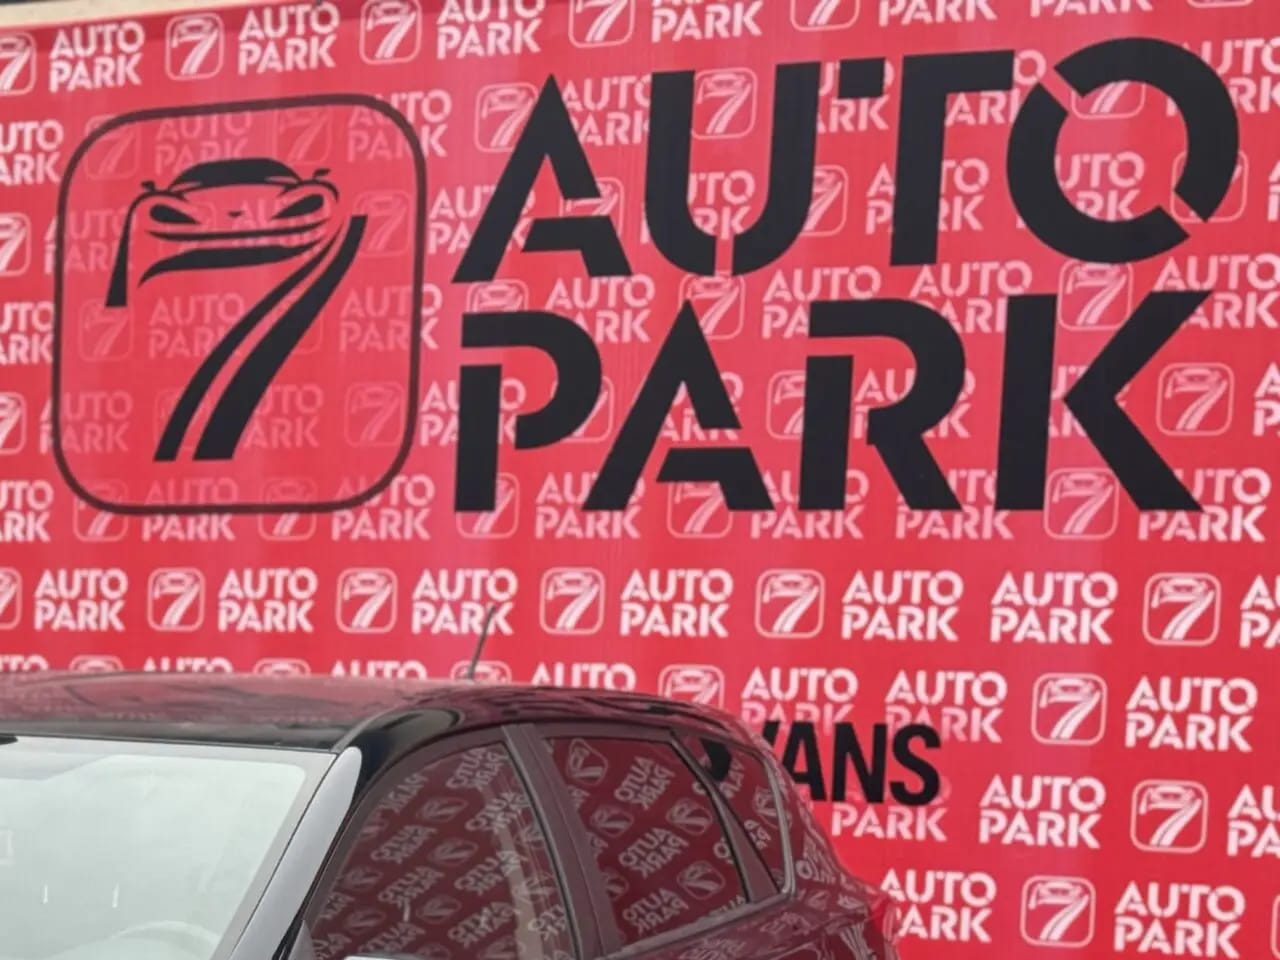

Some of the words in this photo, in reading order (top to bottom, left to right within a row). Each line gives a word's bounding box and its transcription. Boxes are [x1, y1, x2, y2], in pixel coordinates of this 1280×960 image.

[50, 22, 144, 59] AUTO
[239, 3, 339, 43] AUTO
[437, 20, 541, 59] PARK
[652, 2, 762, 43] PARK
[49, 54, 141, 92] PARK
[239, 37, 335, 75] PARK
[451, 37, 1239, 284] AUTO
[544, 274, 655, 309] AUTO
[762, 266, 882, 301] AUTO
[909, 260, 1032, 296] AUTO
[454, 290, 1214, 513] PARK
[142, 509, 235, 541] PARK
[332, 508, 426, 541] PARK
[535, 507, 642, 538] PARK
[752, 508, 864, 539] PARK
[896, 503, 1014, 541] PARK
[1137, 507, 1265, 542] PARK
[35, 569, 128, 600] AUTO
[219, 569, 317, 600] AUTO
[413, 567, 518, 601] AUTO
[620, 568, 733, 604] AUTO
[844, 571, 964, 605] AUTO
[991, 572, 1118, 608] AUTO
[34, 599, 124, 632] PARK
[219, 600, 314, 633] PARK
[413, 601, 514, 636] PARK
[620, 601, 728, 639] PARK
[842, 605, 958, 641] PARK
[991, 608, 1112, 645] PARK
[532, 661, 636, 694] AUTO
[741, 667, 857, 701] AUTO
[885, 670, 1007, 706] AUTO
[1127, 676, 1257, 714] AUTO
[1126, 713, 1252, 753] PARK
[980, 776, 1106, 811] AUTO
[832, 806, 947, 841] PARK
[979, 810, 1100, 848] PARK
[881, 869, 996, 903] AUTO
[1115, 883, 1245, 921] AUTO
[1114, 918, 1240, 958] PARK
